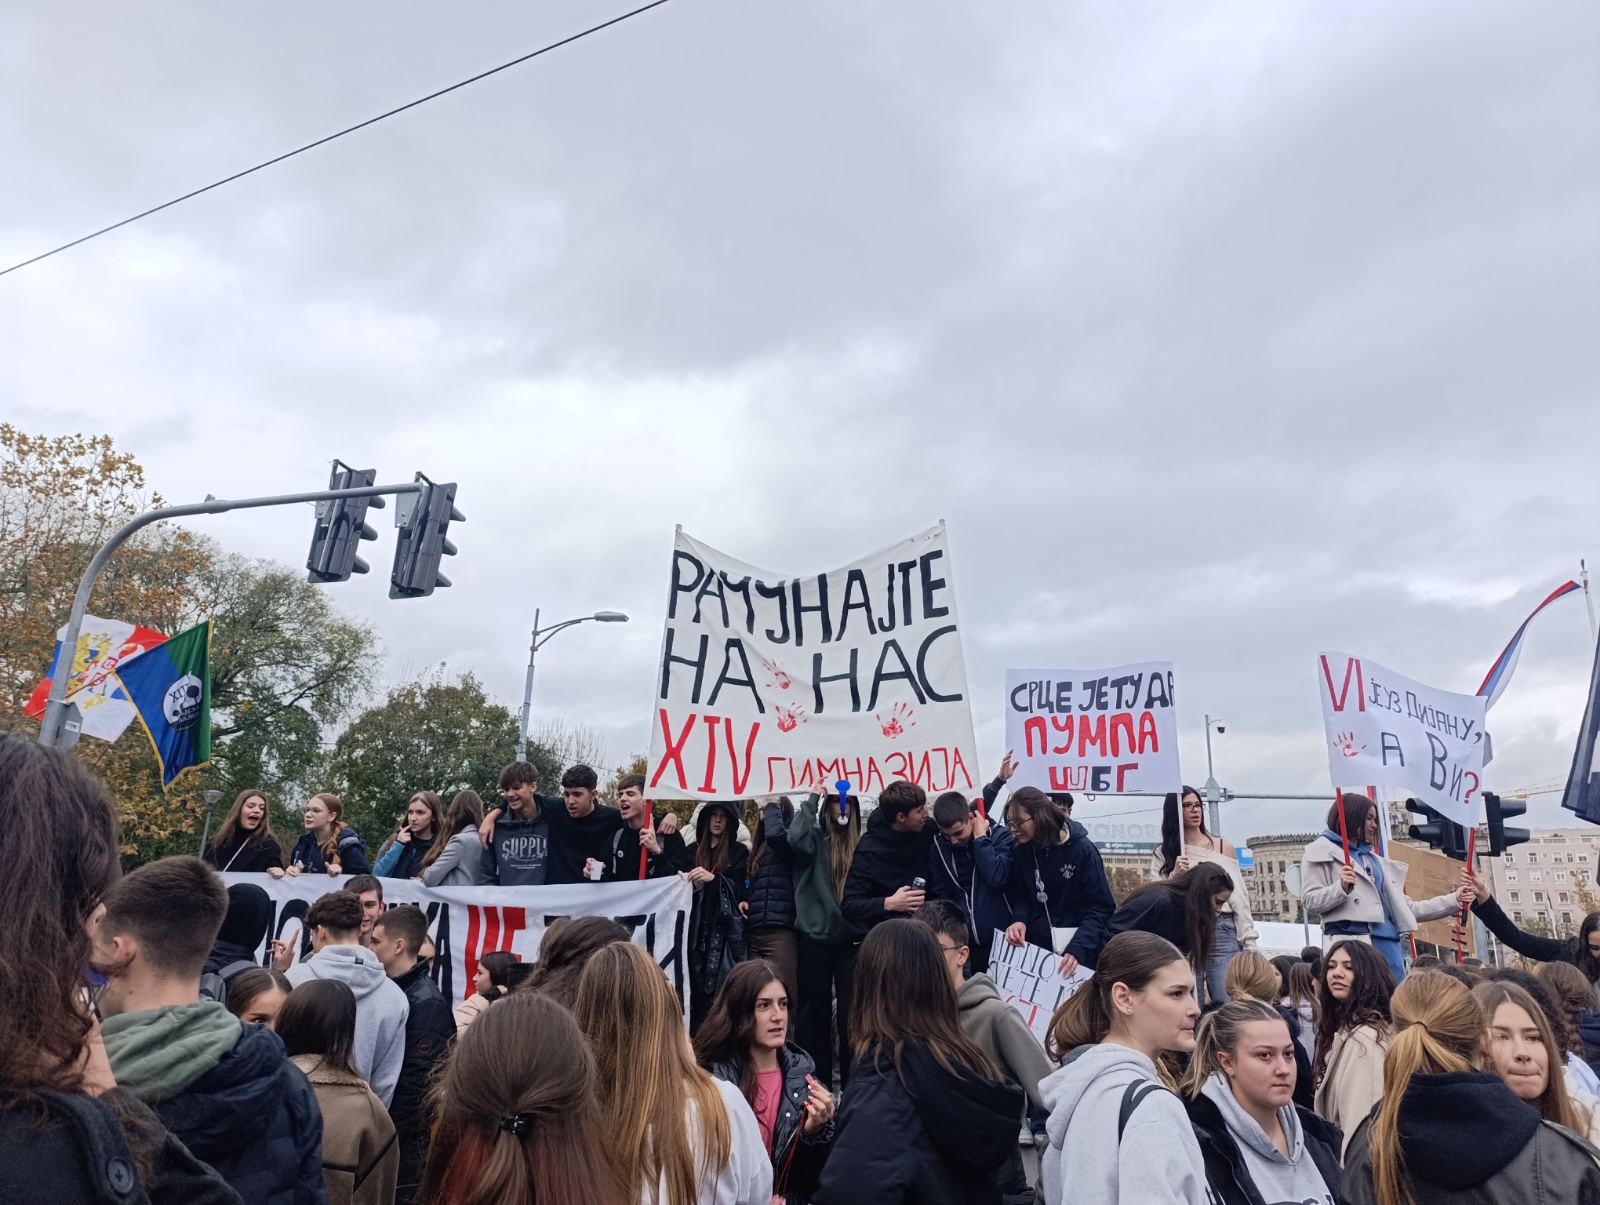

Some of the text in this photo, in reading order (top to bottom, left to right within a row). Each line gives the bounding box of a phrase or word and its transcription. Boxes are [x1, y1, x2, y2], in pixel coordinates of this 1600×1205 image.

[668, 550, 949, 647] РАЧУНАЈТЕ
[660, 624, 963, 714] НА НАС
[1010, 679, 1073, 714] СРЦЕ
[1320, 654, 1366, 712] VI
[649, 708, 973, 795] XIV ГИМНАЗИЈА
[1024, 711, 1159, 758] ПУМПА
[1381, 731, 1479, 804] А ВИ?
